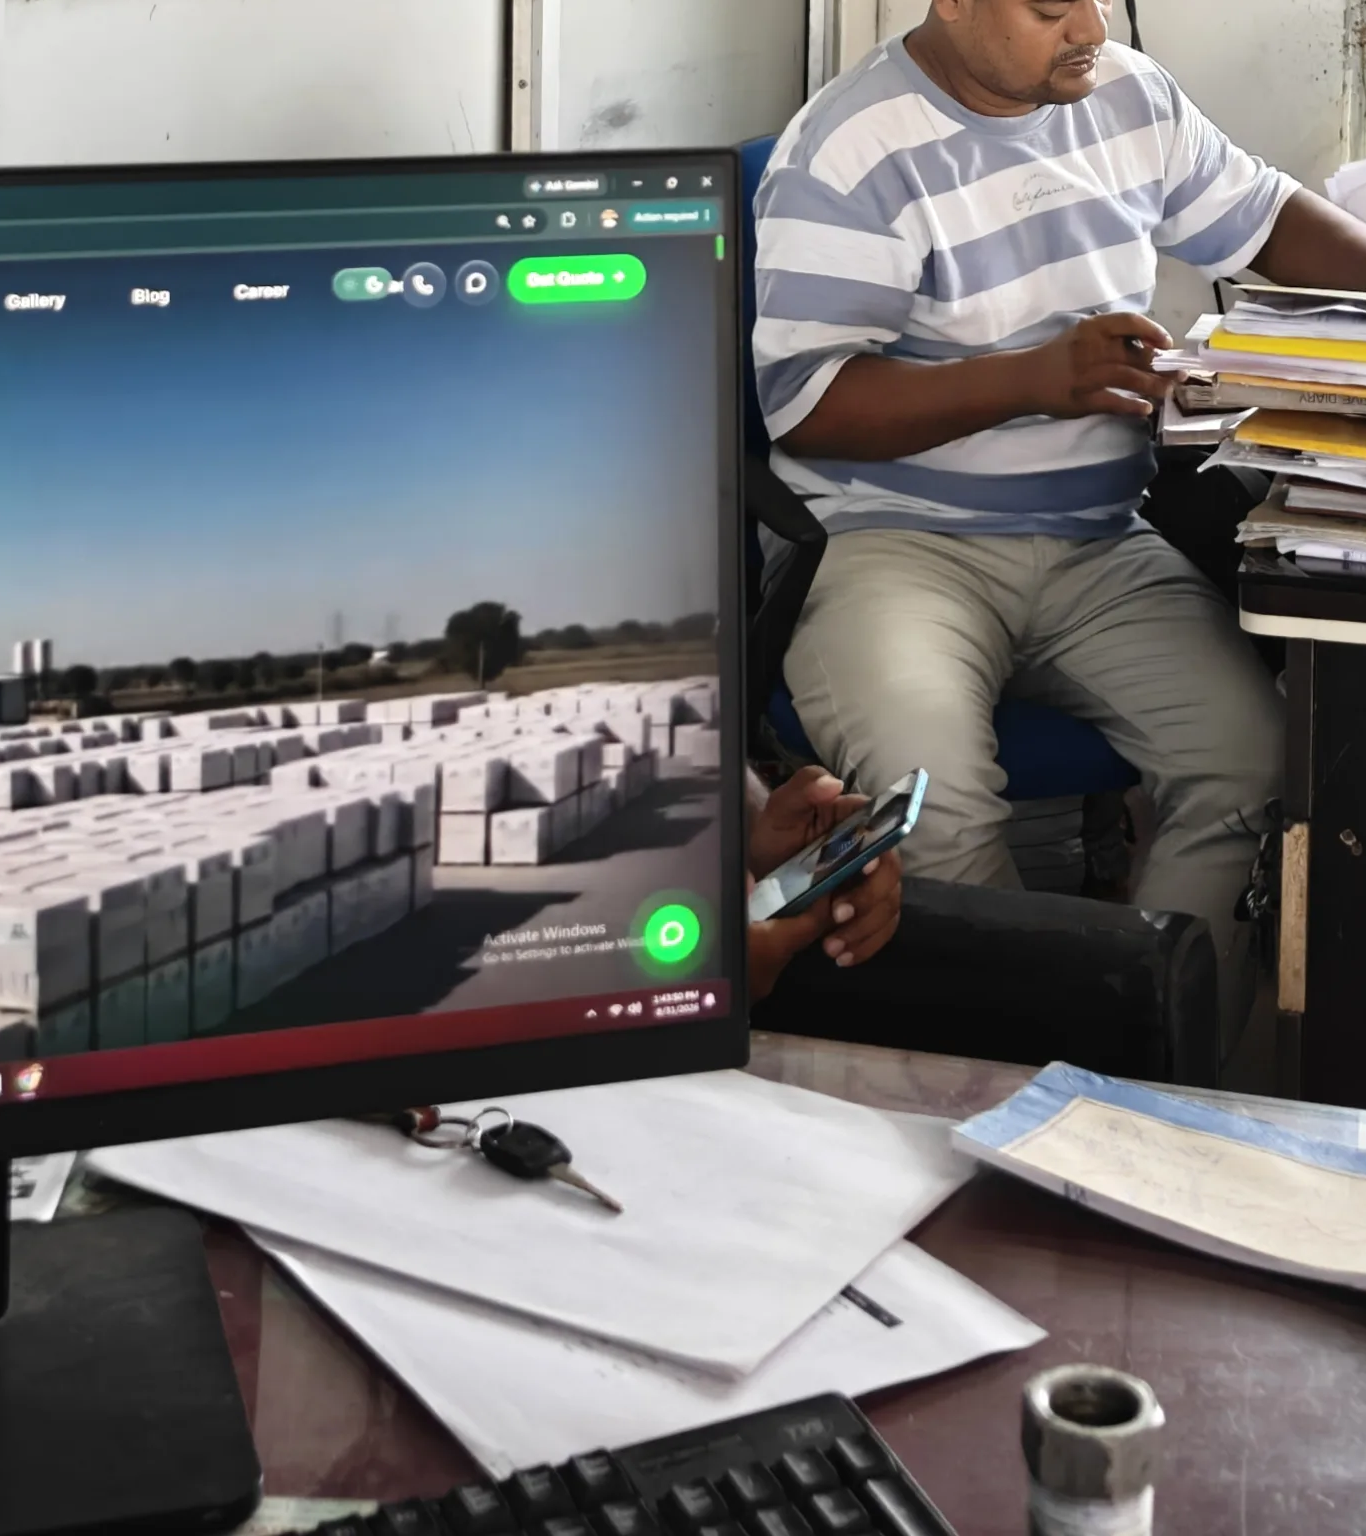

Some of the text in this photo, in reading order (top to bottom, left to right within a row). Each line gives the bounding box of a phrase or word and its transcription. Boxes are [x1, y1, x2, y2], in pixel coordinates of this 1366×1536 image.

[130, 287, 171, 307] Blog
[234, 282, 290, 301] Career
[4, 292, 67, 312] Gallery
[1299, 392, 1338, 405] DIARY
[484, 922, 607, 947] Activate Windows
[483, 952, 499, 964] Go
[501, 951, 514, 962] to
[516, 945, 558, 961] Settings
[574, 940, 615, 955] activate
